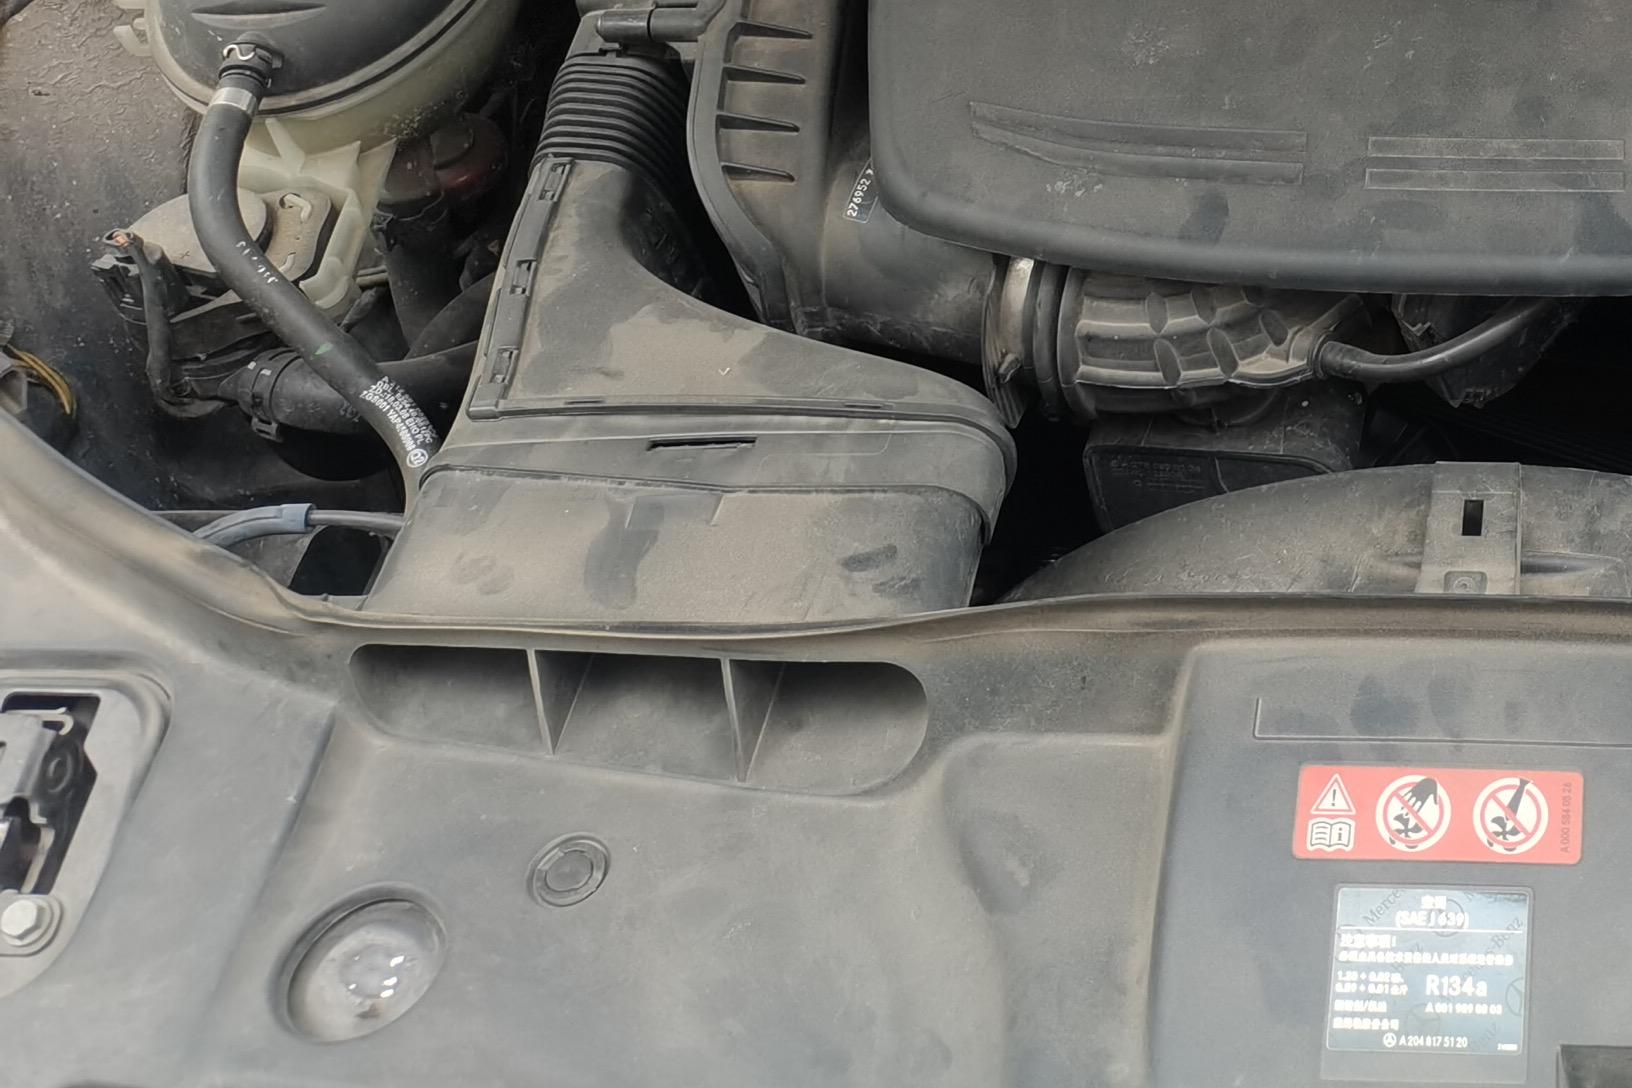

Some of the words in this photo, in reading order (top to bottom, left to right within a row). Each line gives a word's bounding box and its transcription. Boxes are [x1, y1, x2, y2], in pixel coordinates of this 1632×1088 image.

[846, 178, 872, 217] 276952
[1425, 974, 1488, 997] R134a
[1407, 1035, 1424, 1046] 204
[1443, 1036, 1455, 1047] 51
[1455, 1036, 1468, 1048] 20
